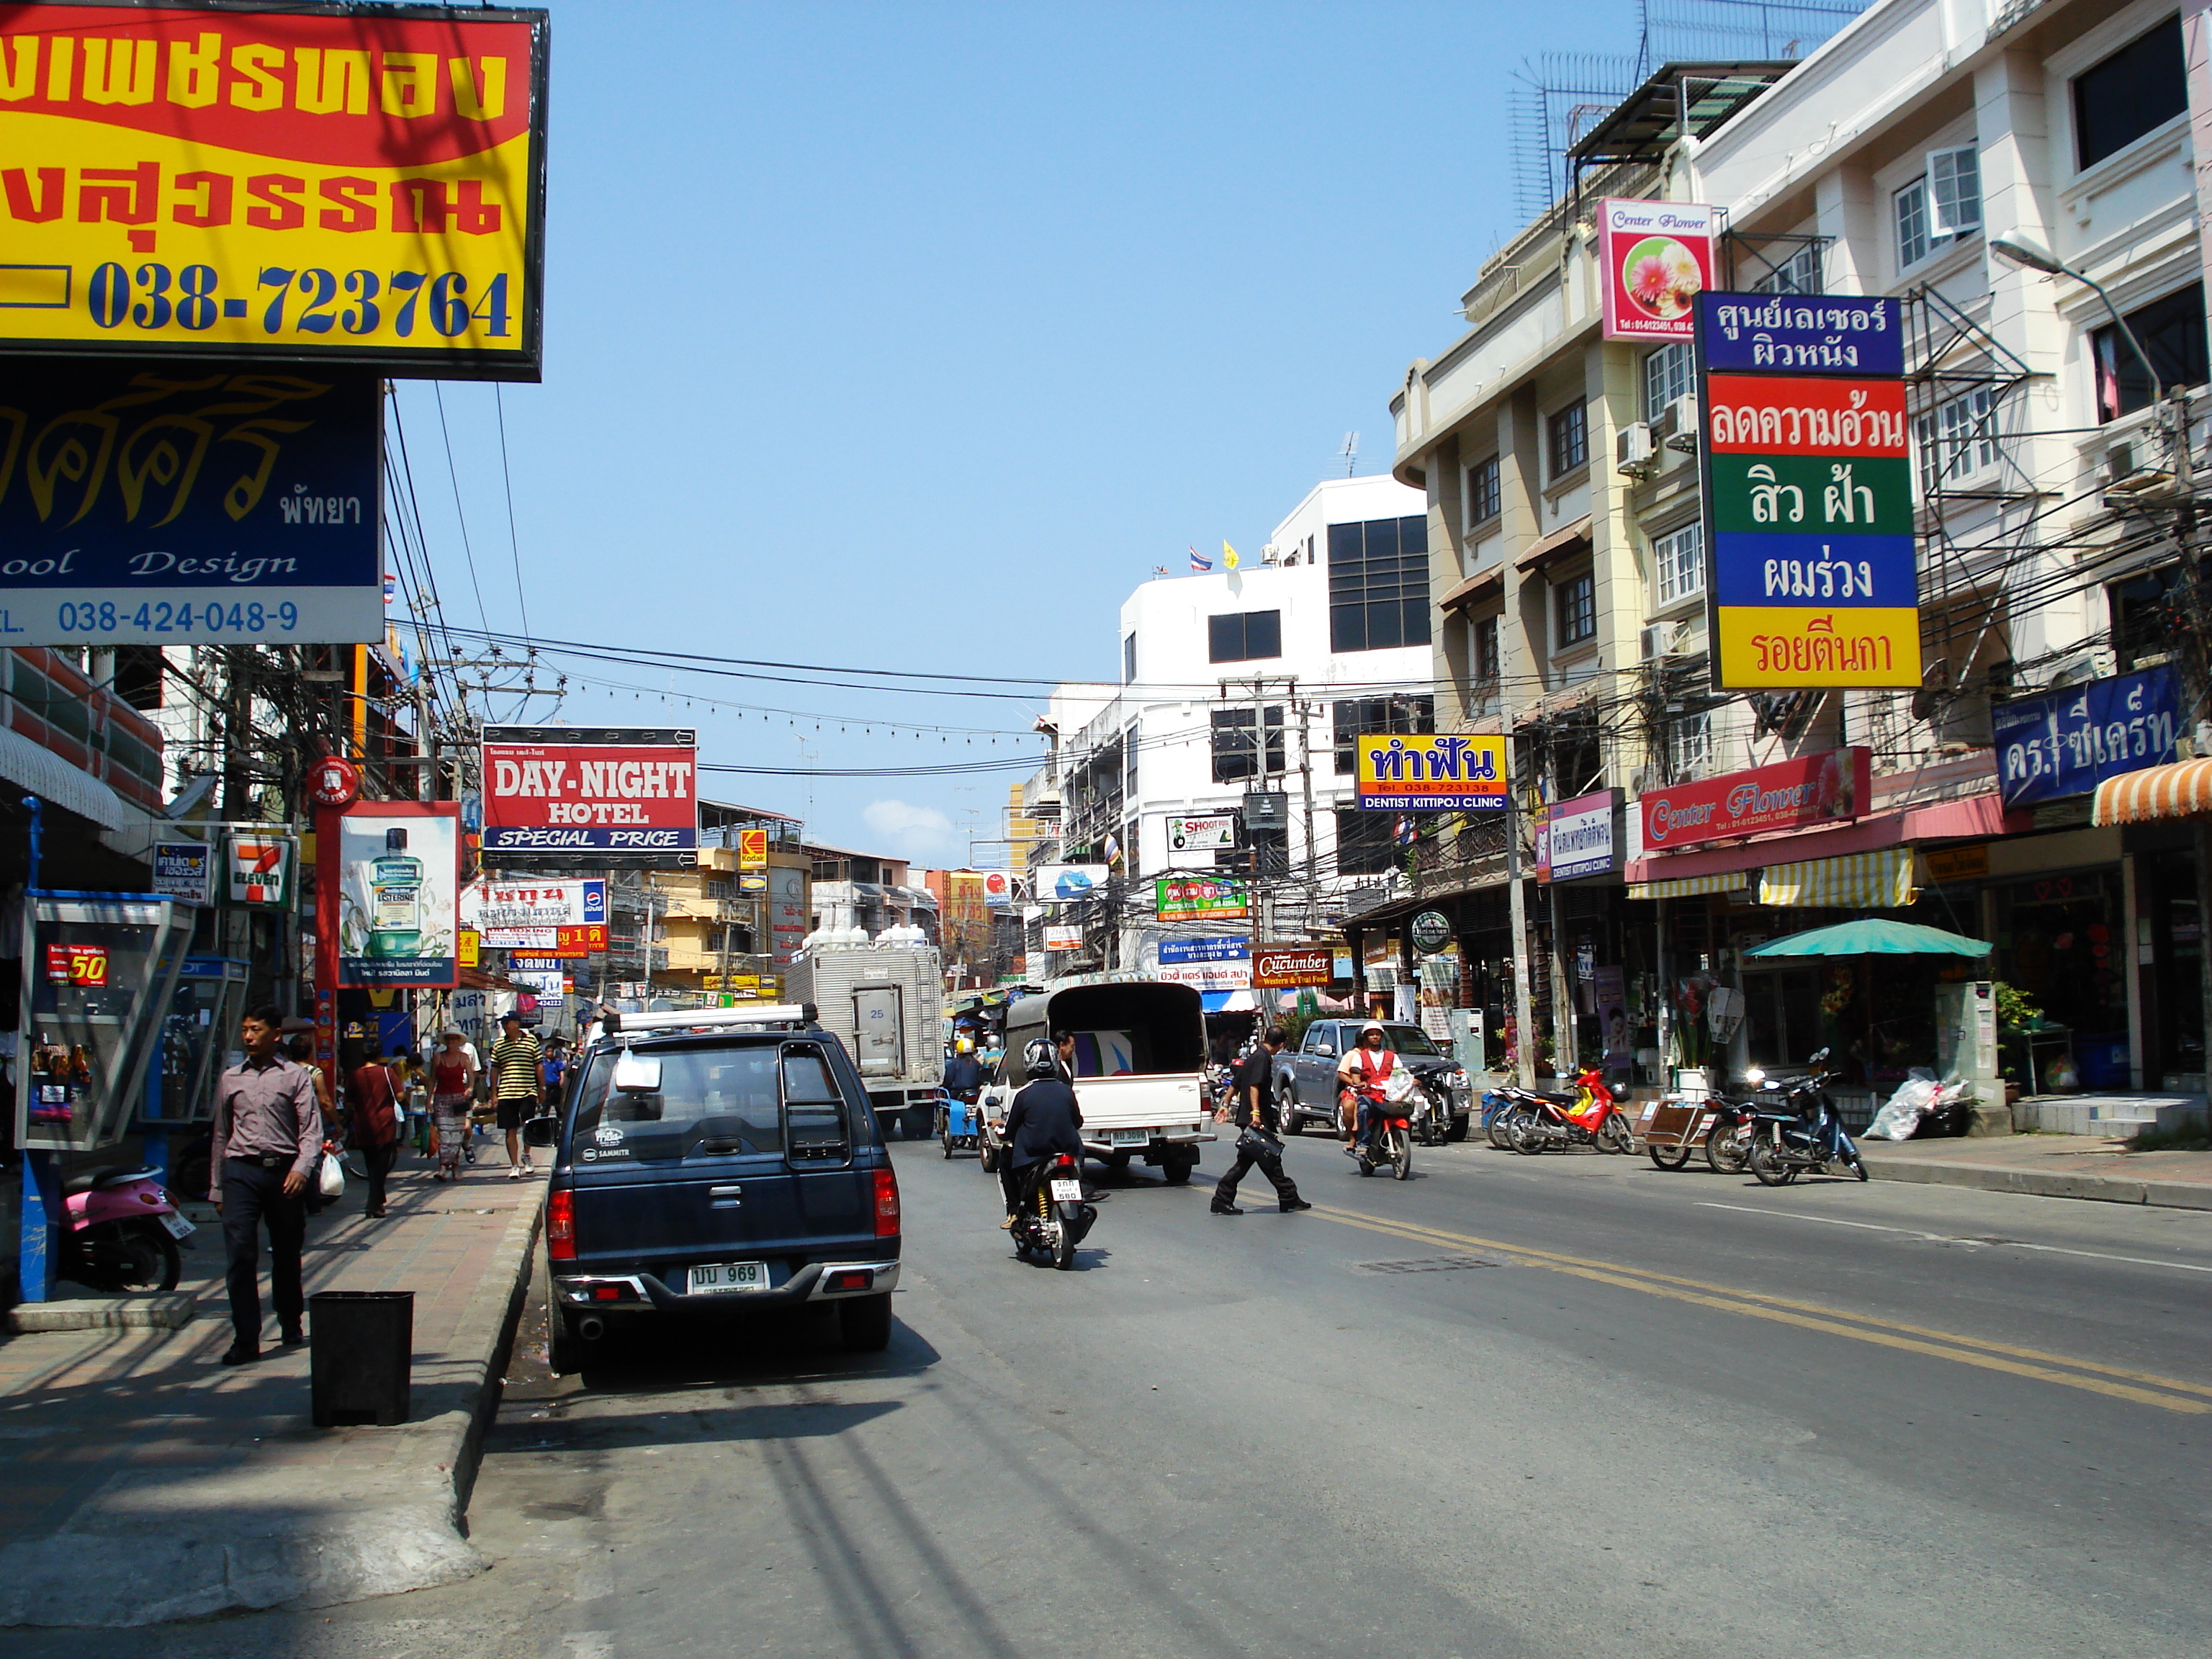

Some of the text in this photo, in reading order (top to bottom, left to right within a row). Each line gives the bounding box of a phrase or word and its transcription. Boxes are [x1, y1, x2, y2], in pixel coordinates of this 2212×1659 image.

[1612, 211, 1707, 229] Center Flower
[89, 261, 512, 338] 038-723764
[1717, 297, 1887, 341] ศูนย์เลเซอร์
[1753, 333, 1859, 368] ผิวหนัง
[1711, 389, 1905, 449] ลดความอ้วน
[280, 484, 360, 524] พัทยา
[1748, 462, 1875, 523] สิว ฝ้า
[128, 551, 299, 583] Design
[1764, 545, 1874, 598] ผมร่วง
[58, 601, 299, 632] 038-424-048-9
[1750, 614, 1892, 673] รอยตีนกา
[1370, 737, 1497, 780] ทำฟัน
[494, 760, 691, 799] DAY-NIGHT
[548, 803, 649, 824] HOTEL
[1365, 798, 1503, 808] DENTIST KITTIPOJ CLINIC
[1650, 781, 1816, 842] Center Flower
[498, 830, 680, 847] SPECIAL PRICE
[1184, 821, 1218, 834] SHOOT
[1553, 866, 1572, 878] DENTIST
[1593, 858, 1610, 871] CLINIC
[68, 956, 107, 979] 50
[1161, 968, 1248, 980] บิวตี้ แคร์ แอนด์ สปา
[1259, 953, 1328, 977] Cucumber
[1263, 976, 1288, 985] Western
[1313, 975, 1328, 984] Food
[728, 1266, 756, 1282] 969
